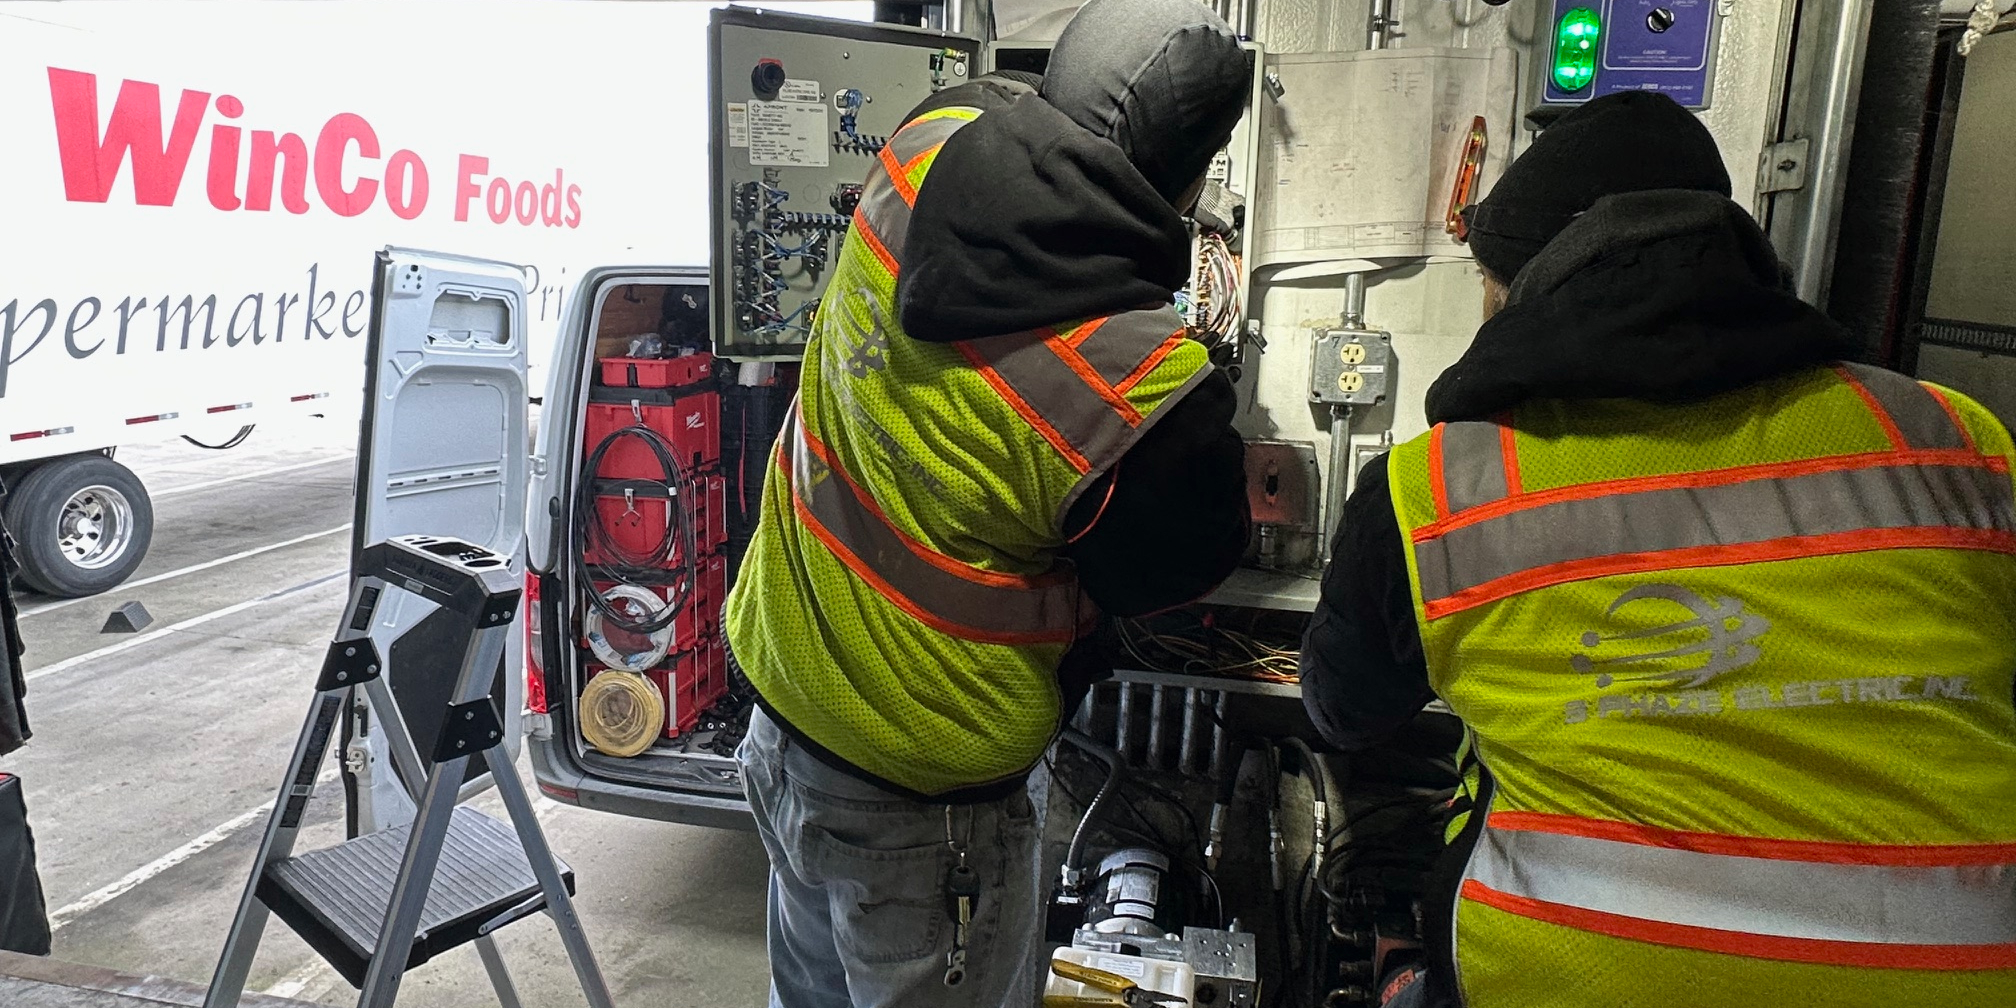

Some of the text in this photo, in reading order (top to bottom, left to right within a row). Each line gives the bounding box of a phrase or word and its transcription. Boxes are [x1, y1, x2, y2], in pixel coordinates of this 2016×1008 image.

[47, 66, 582, 229] WinCo Foods
[1599, 689, 1724, 718] PHAZE
